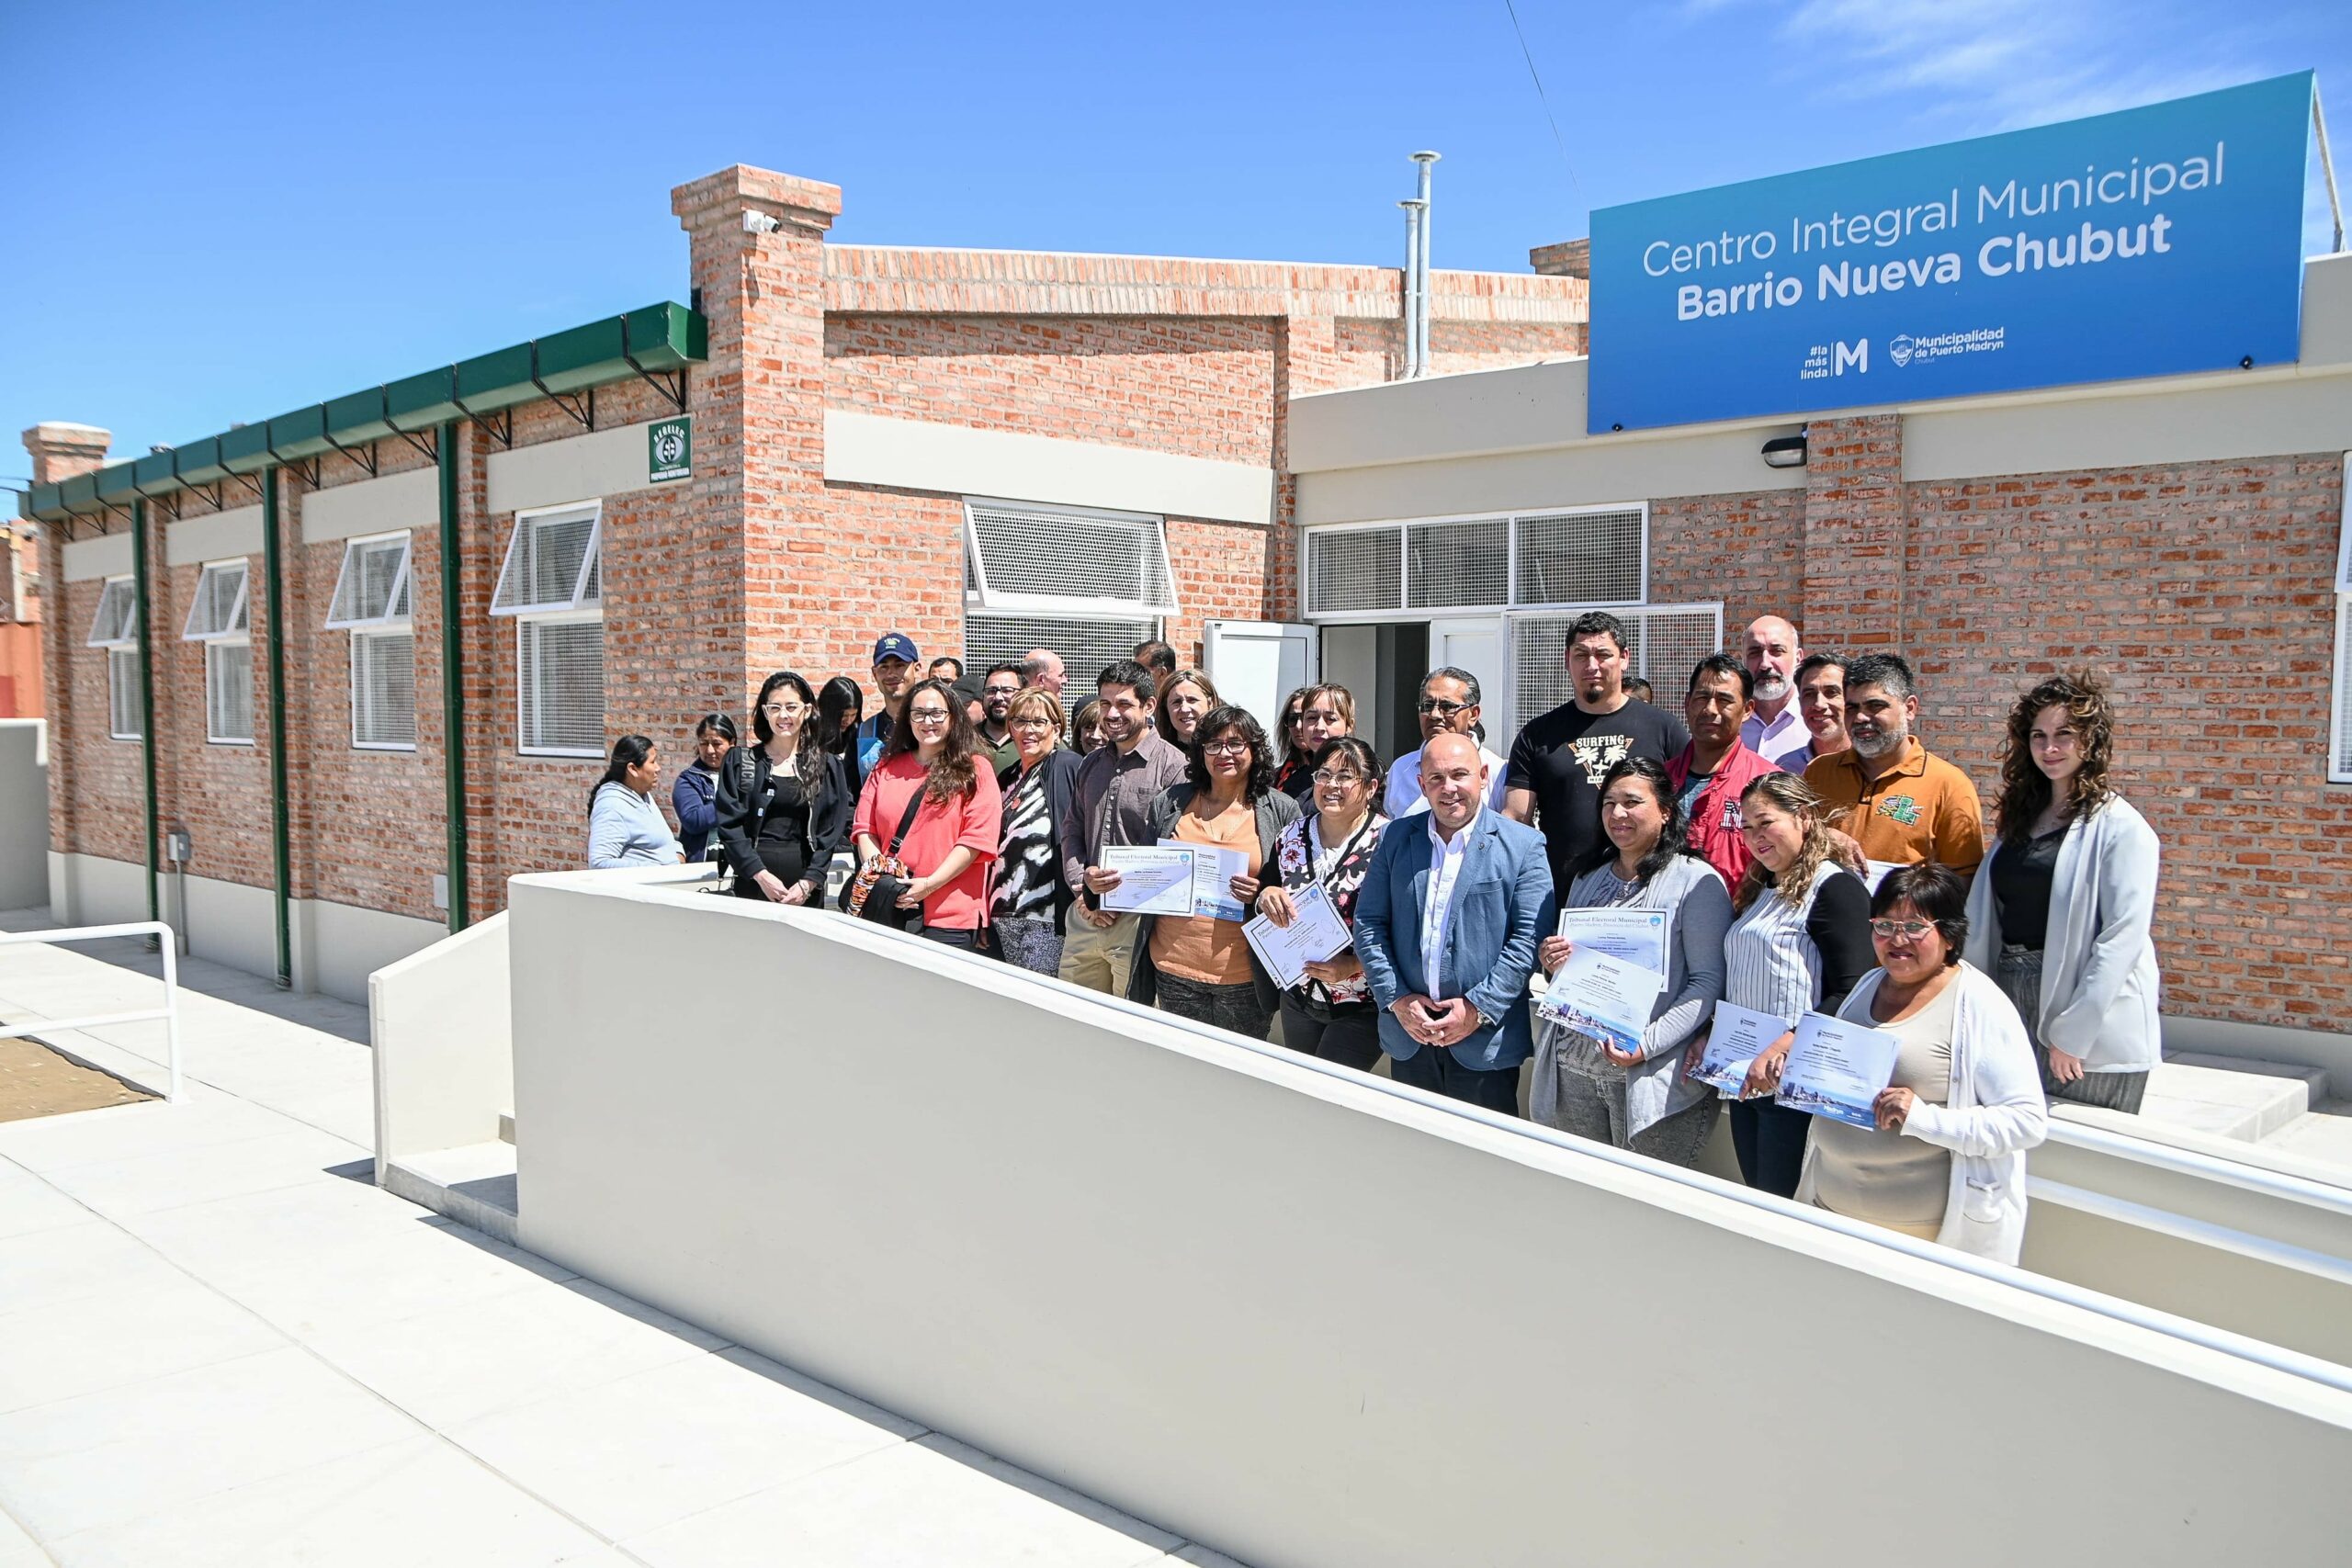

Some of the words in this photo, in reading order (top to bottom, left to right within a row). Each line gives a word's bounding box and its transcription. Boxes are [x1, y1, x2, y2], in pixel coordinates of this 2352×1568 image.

[1643, 231, 1777, 276] Centro
[1792, 187, 1958, 254] Integral
[1977, 141, 2224, 224] Municipal
[1678, 271, 1803, 321] Barrio
[1817, 253, 1962, 301] Nueva
[1978, 213, 2172, 277] Chubut
[1916, 327, 2004, 348] Municipalidad
[1810, 345, 1827, 356] #la
[1915, 348, 1928, 358] de
[1929, 344, 1964, 357] Puerto
[1965, 339, 2004, 353] Madryn
[1804, 355, 1827, 368] más
[1835, 337, 1868, 377] M
[1801, 367, 1828, 380] linda
[1576, 735, 1625, 748] SURFING
[1618, 917, 1647, 925] Municipal
